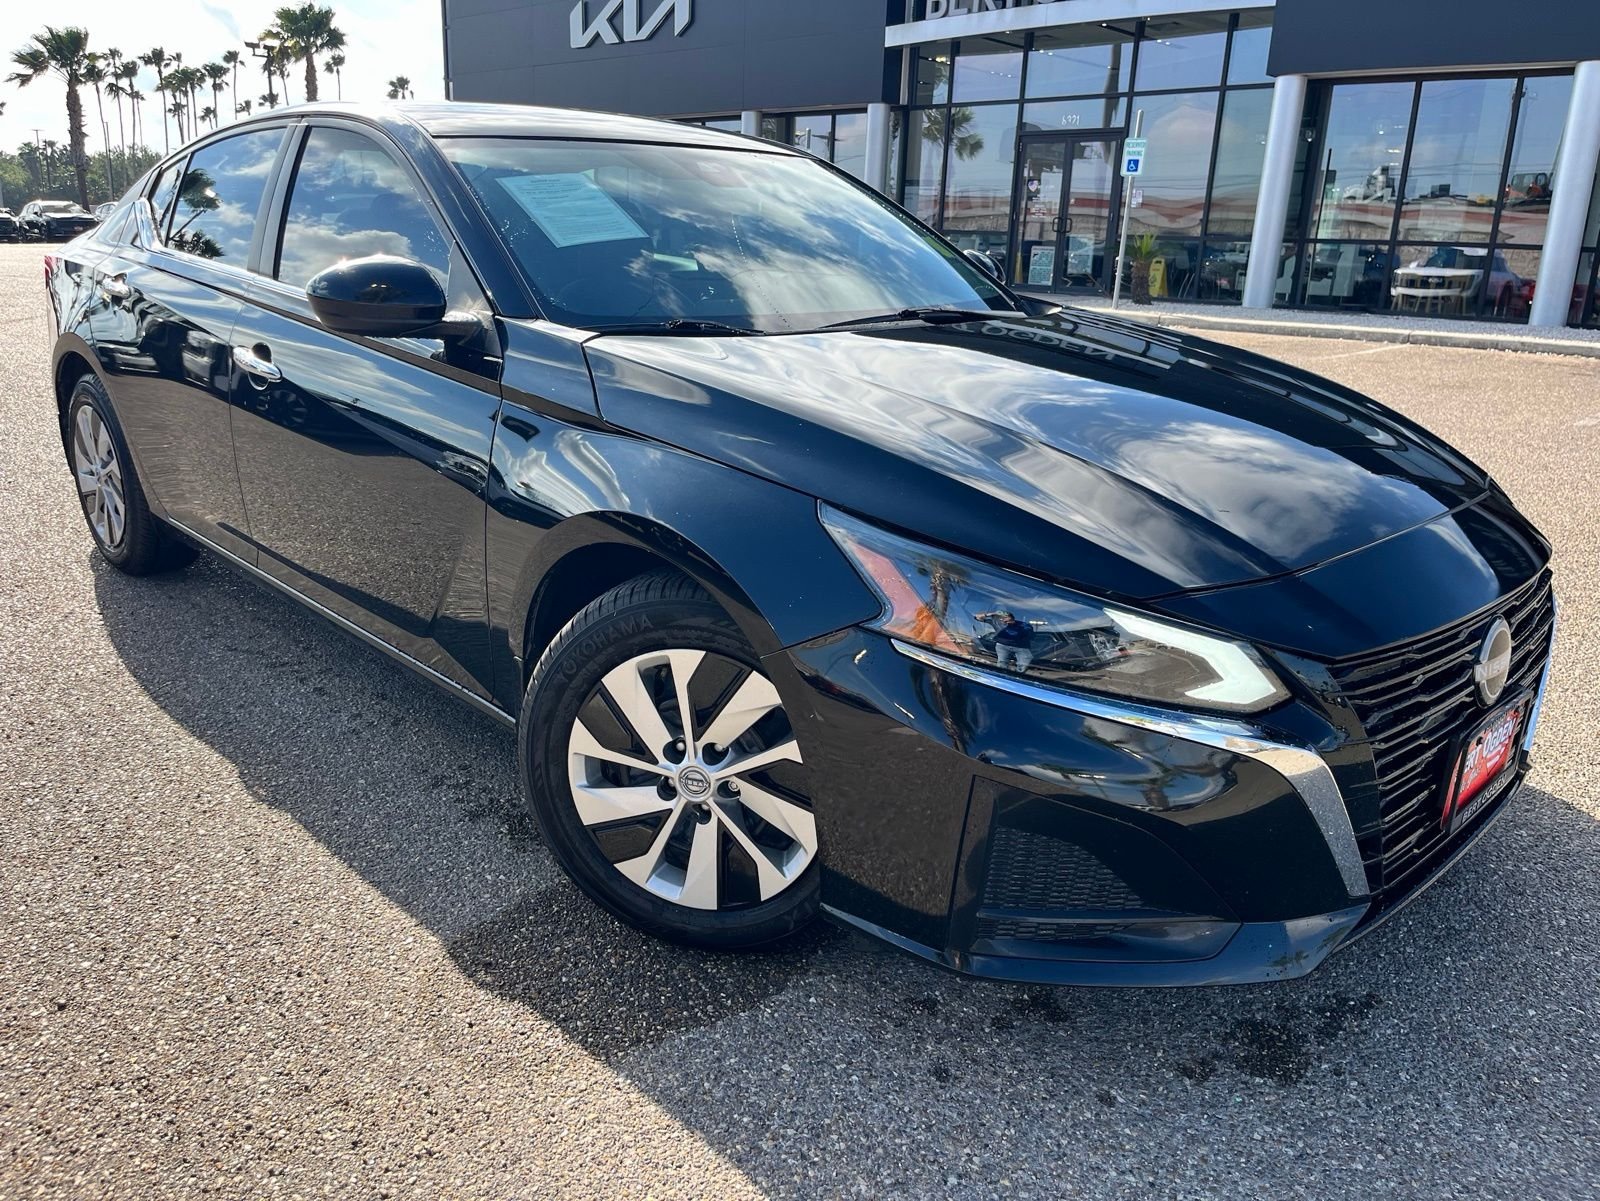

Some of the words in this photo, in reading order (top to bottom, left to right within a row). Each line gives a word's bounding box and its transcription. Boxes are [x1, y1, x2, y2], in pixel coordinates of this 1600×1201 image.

[569, 0, 691, 48] KIA
[552, 613, 654, 685] YOKOHAMA
[1483, 717, 1516, 757] OGDEN
[680, 778, 709, 788] NISSAN
[1462, 797, 1482, 823] BERT
[1481, 774, 1506, 804] OGDEN
